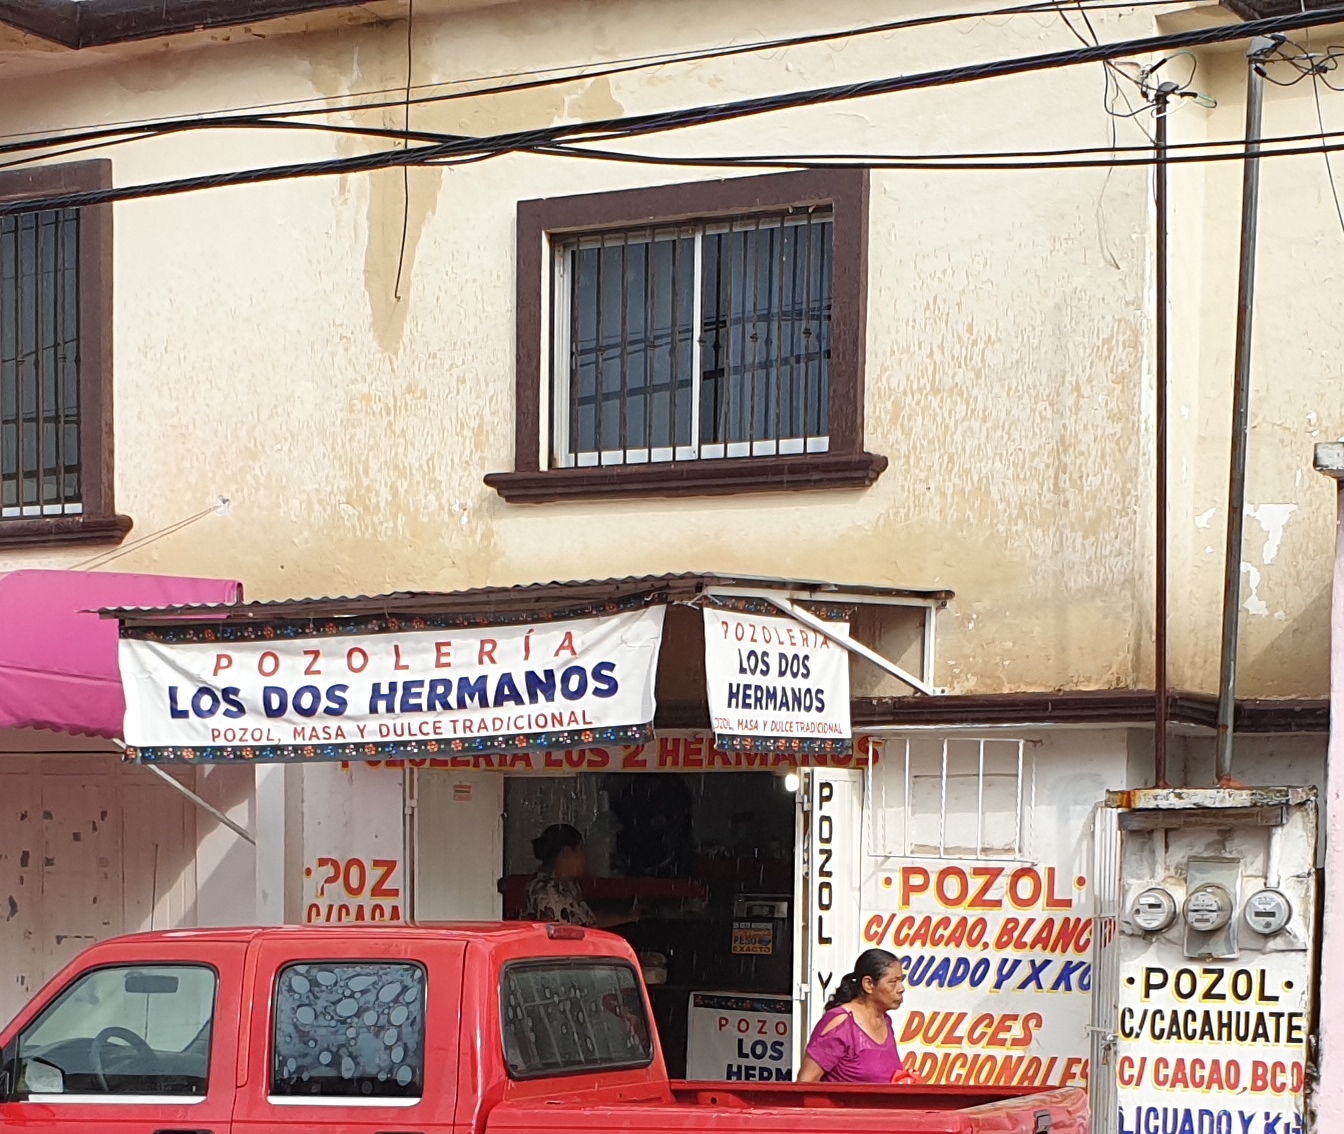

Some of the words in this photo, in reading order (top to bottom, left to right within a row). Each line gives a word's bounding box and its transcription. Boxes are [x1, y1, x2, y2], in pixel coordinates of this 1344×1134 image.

[213, 629, 578, 677] POZOLERÍA
[738, 649, 770, 676] LOS
[778, 653, 810, 679] DOS
[168, 686, 246, 718] LOS
[263, 684, 349, 718] DOS
[369, 661, 618, 714] HERMANOS
[727, 683, 825, 713] HERMANOS
[211, 727, 281, 744] POZOL,
[293, 724, 346, 741] MASA
[357, 724, 367, 739] Y
[379, 720, 443, 738] DULCE
[450, 710, 592, 734] TRADICIONAL
[737, 719, 758, 731] MASA
[763, 720, 767, 731] Y
[771, 720, 793, 733] DULCE
[796, 721, 843, 734] TRADICIONAL
[899, 866, 1072, 909] POZOL
[995, 917, 1094, 953] BLANC
[993, 958, 1022, 990] Y
[1019, 959, 1052, 990] X
[1143, 967, 1280, 1001] POZOL
[899, 1011, 1043, 1047] DULCES
[737, 1038, 784, 1061] LOS
